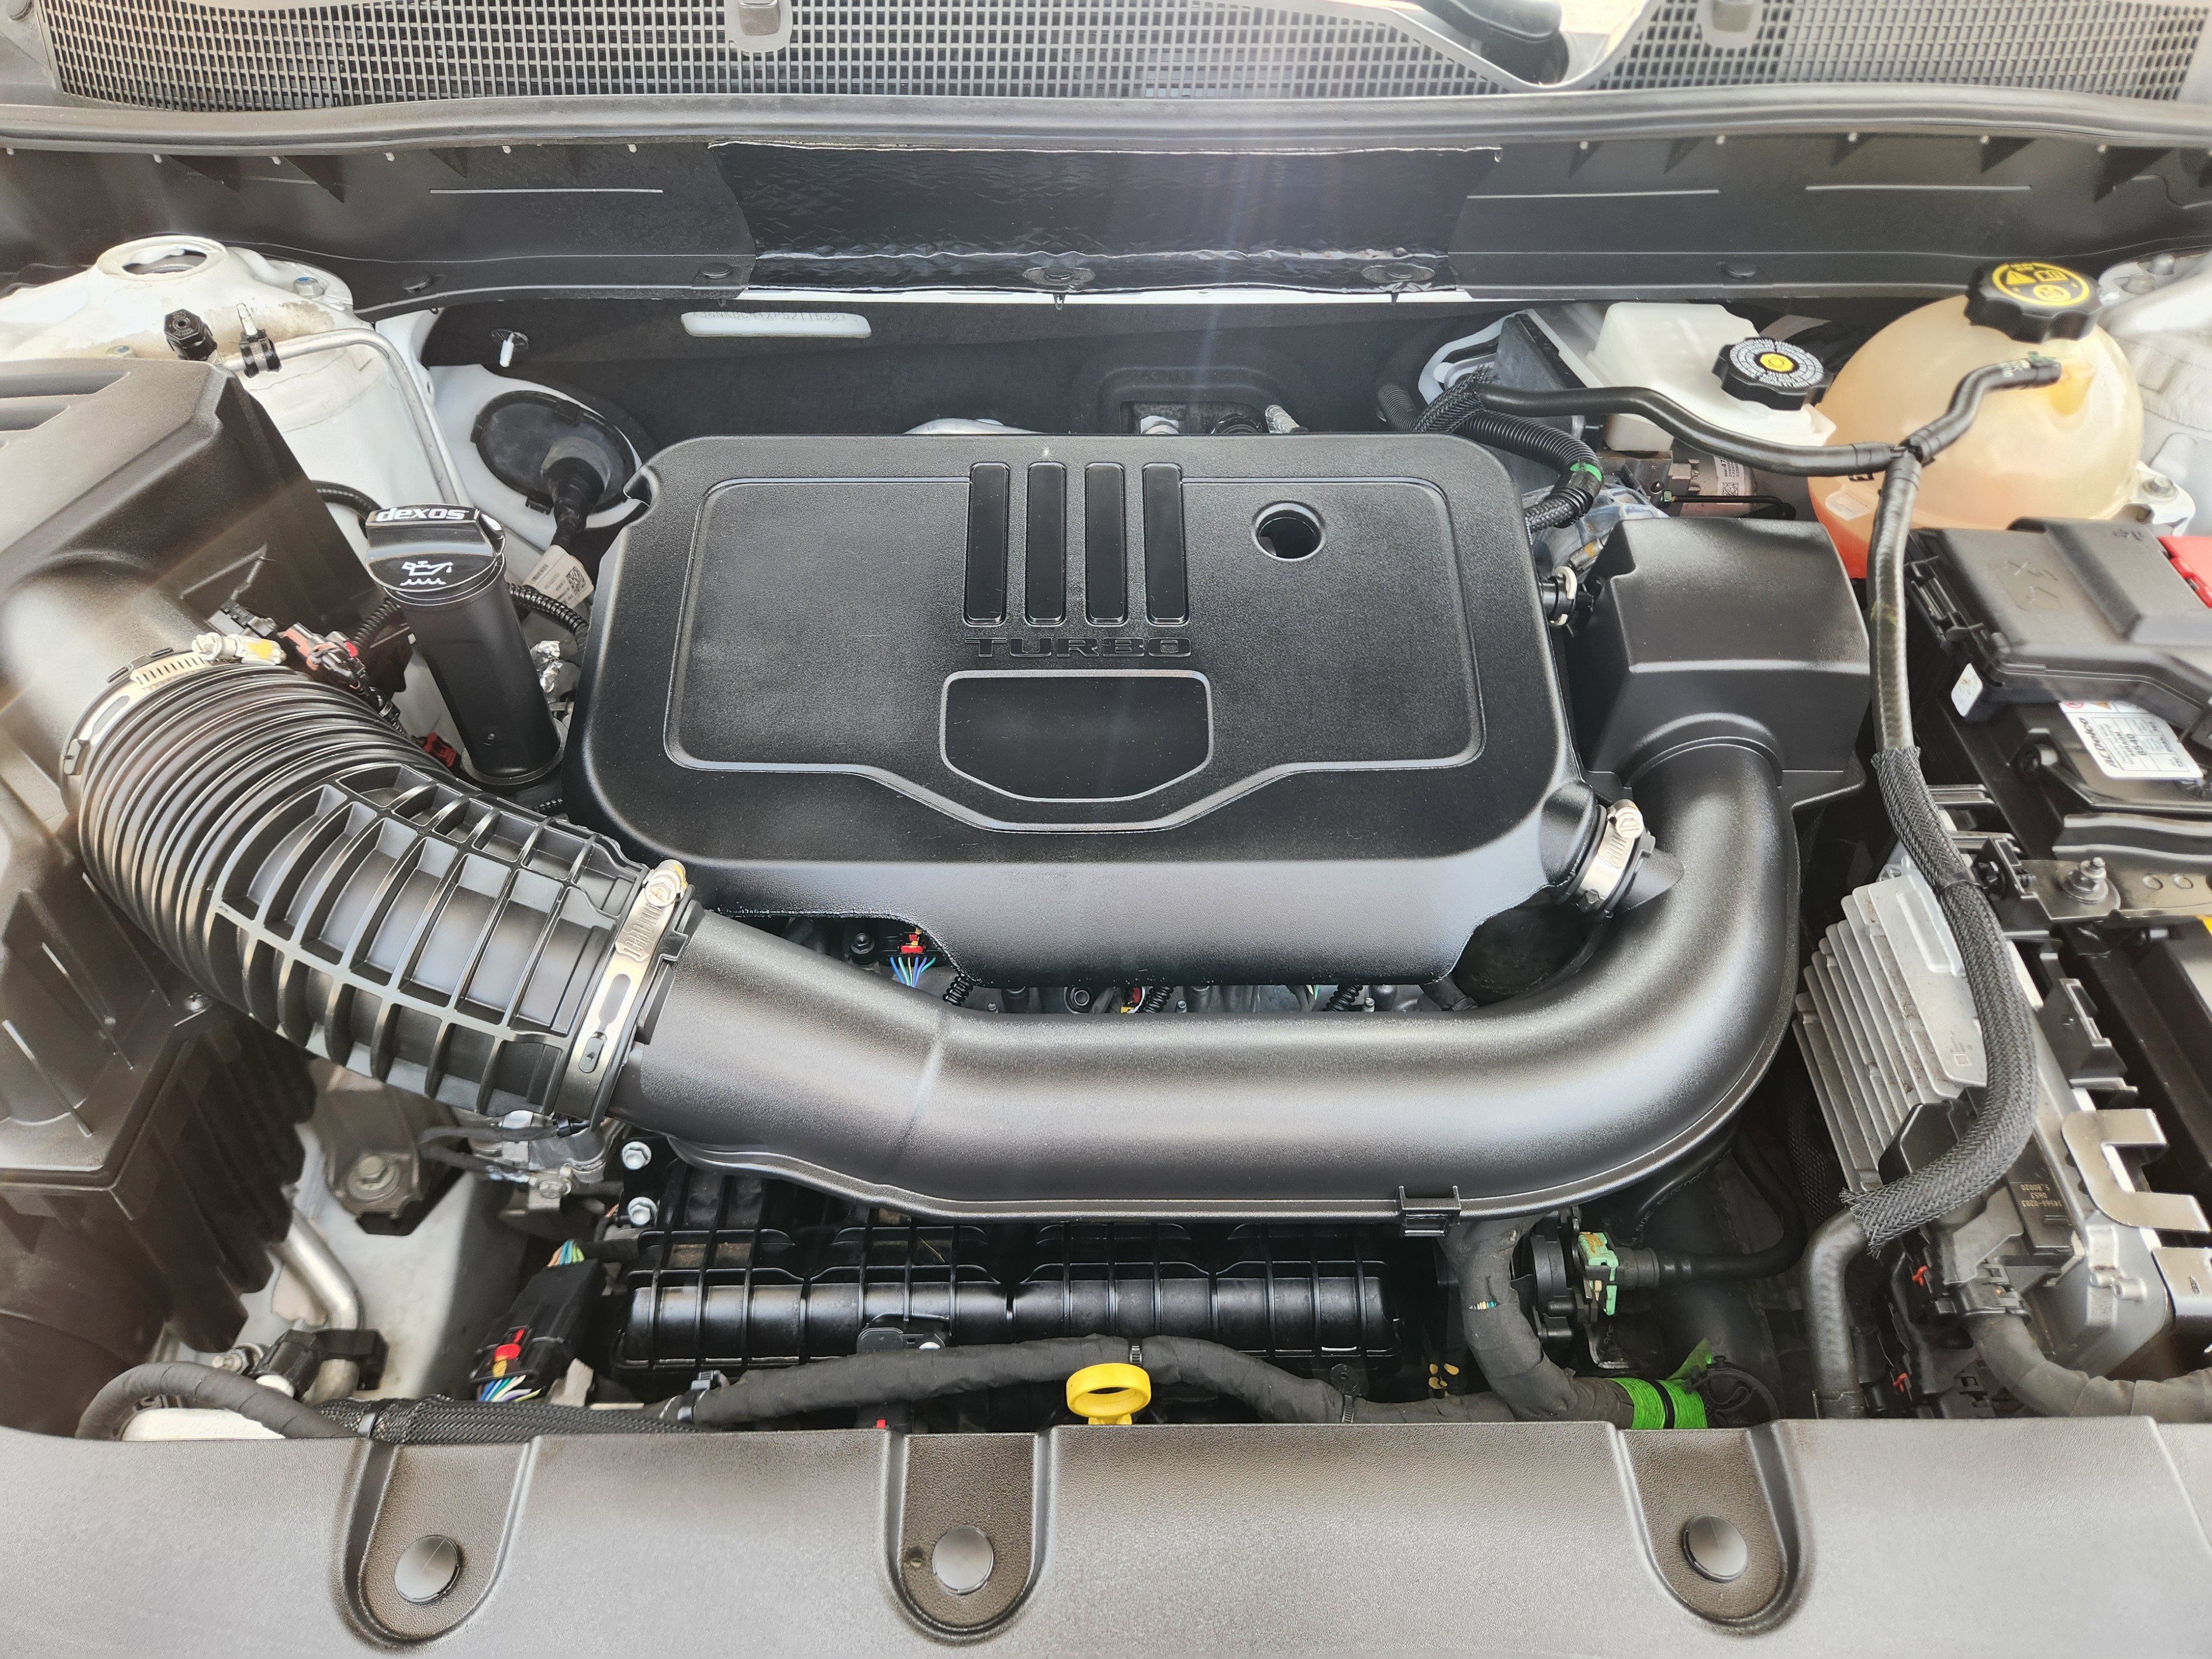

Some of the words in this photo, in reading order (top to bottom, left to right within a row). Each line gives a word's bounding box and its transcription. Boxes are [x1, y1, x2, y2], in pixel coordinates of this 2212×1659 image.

[375, 507, 466, 521] dexos
[964, 637, 1192, 658] TURBO
[2079, 717, 2119, 769] ACDelco
[2126, 733, 2147, 756] 8540
